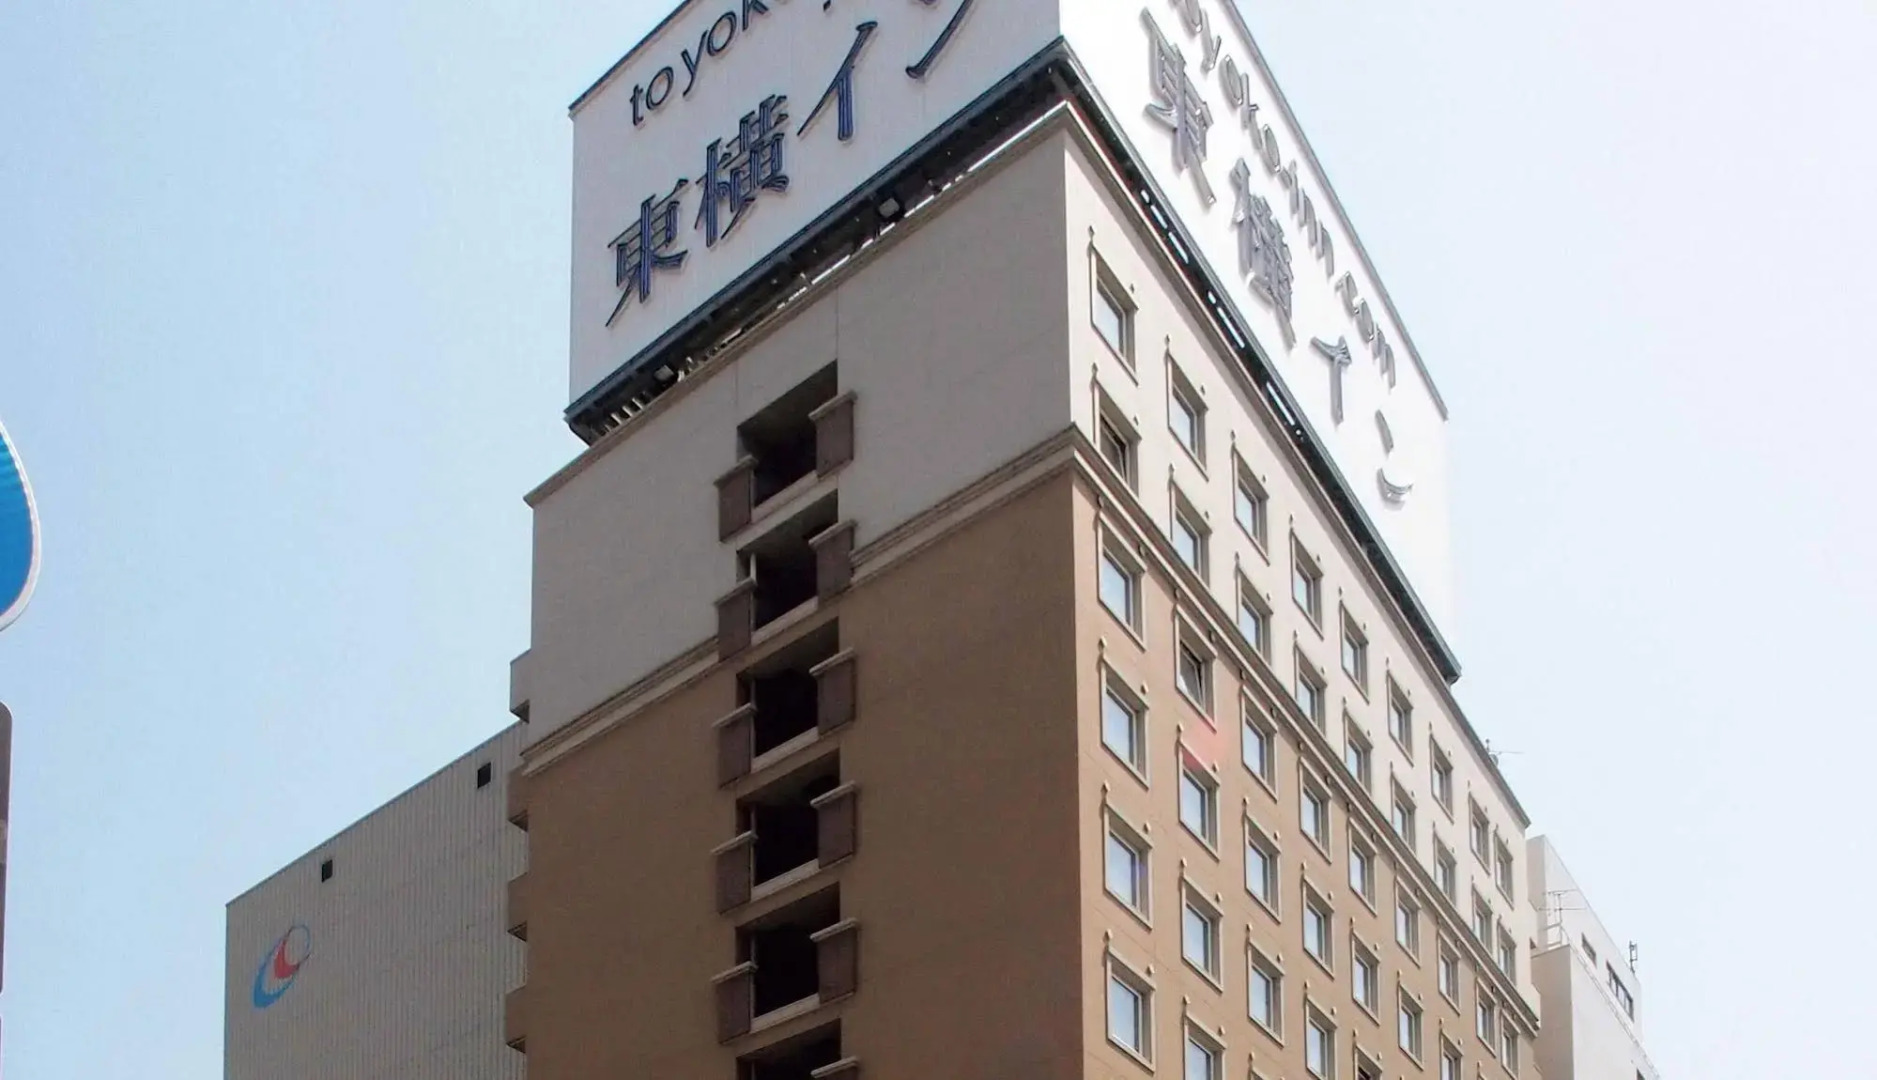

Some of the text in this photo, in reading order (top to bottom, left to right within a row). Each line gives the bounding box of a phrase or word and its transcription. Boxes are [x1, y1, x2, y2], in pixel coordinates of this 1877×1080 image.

[629, 0, 770, 126] toyok
[1140, 7, 1413, 505] 東横イン
[1168, 0, 1396, 390] oyoko-inn.com
